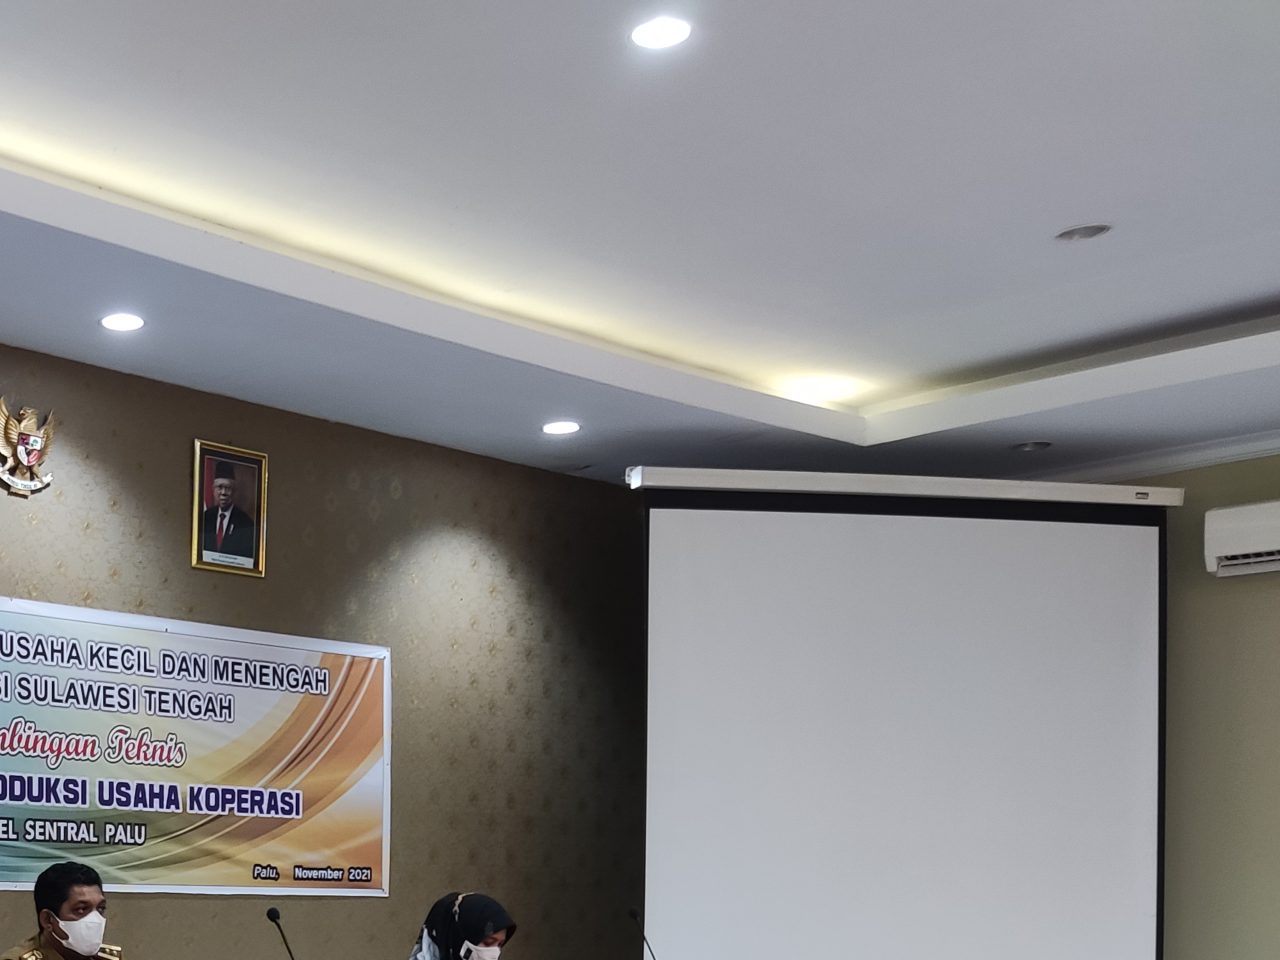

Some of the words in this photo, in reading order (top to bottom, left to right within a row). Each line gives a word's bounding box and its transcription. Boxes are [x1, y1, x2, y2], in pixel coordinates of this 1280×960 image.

[89, 644, 155, 673] KECIL
[161, 654, 207, 679] DAN
[213, 661, 328, 692] MENENGAH
[16, 676, 138, 712] SULAWESI
[144, 690, 233, 720] TENGAH
[107, 727, 186, 766] Teknis
[97, 780, 181, 810] USAHA
[188, 786, 302, 817] KOPERASI
[24, 820, 98, 843] SENTRAL
[104, 823, 146, 845] PALU
[253, 866, 279, 880] Palu,
[294, 867, 344, 881] November
[348, 868, 371, 880] 2021
